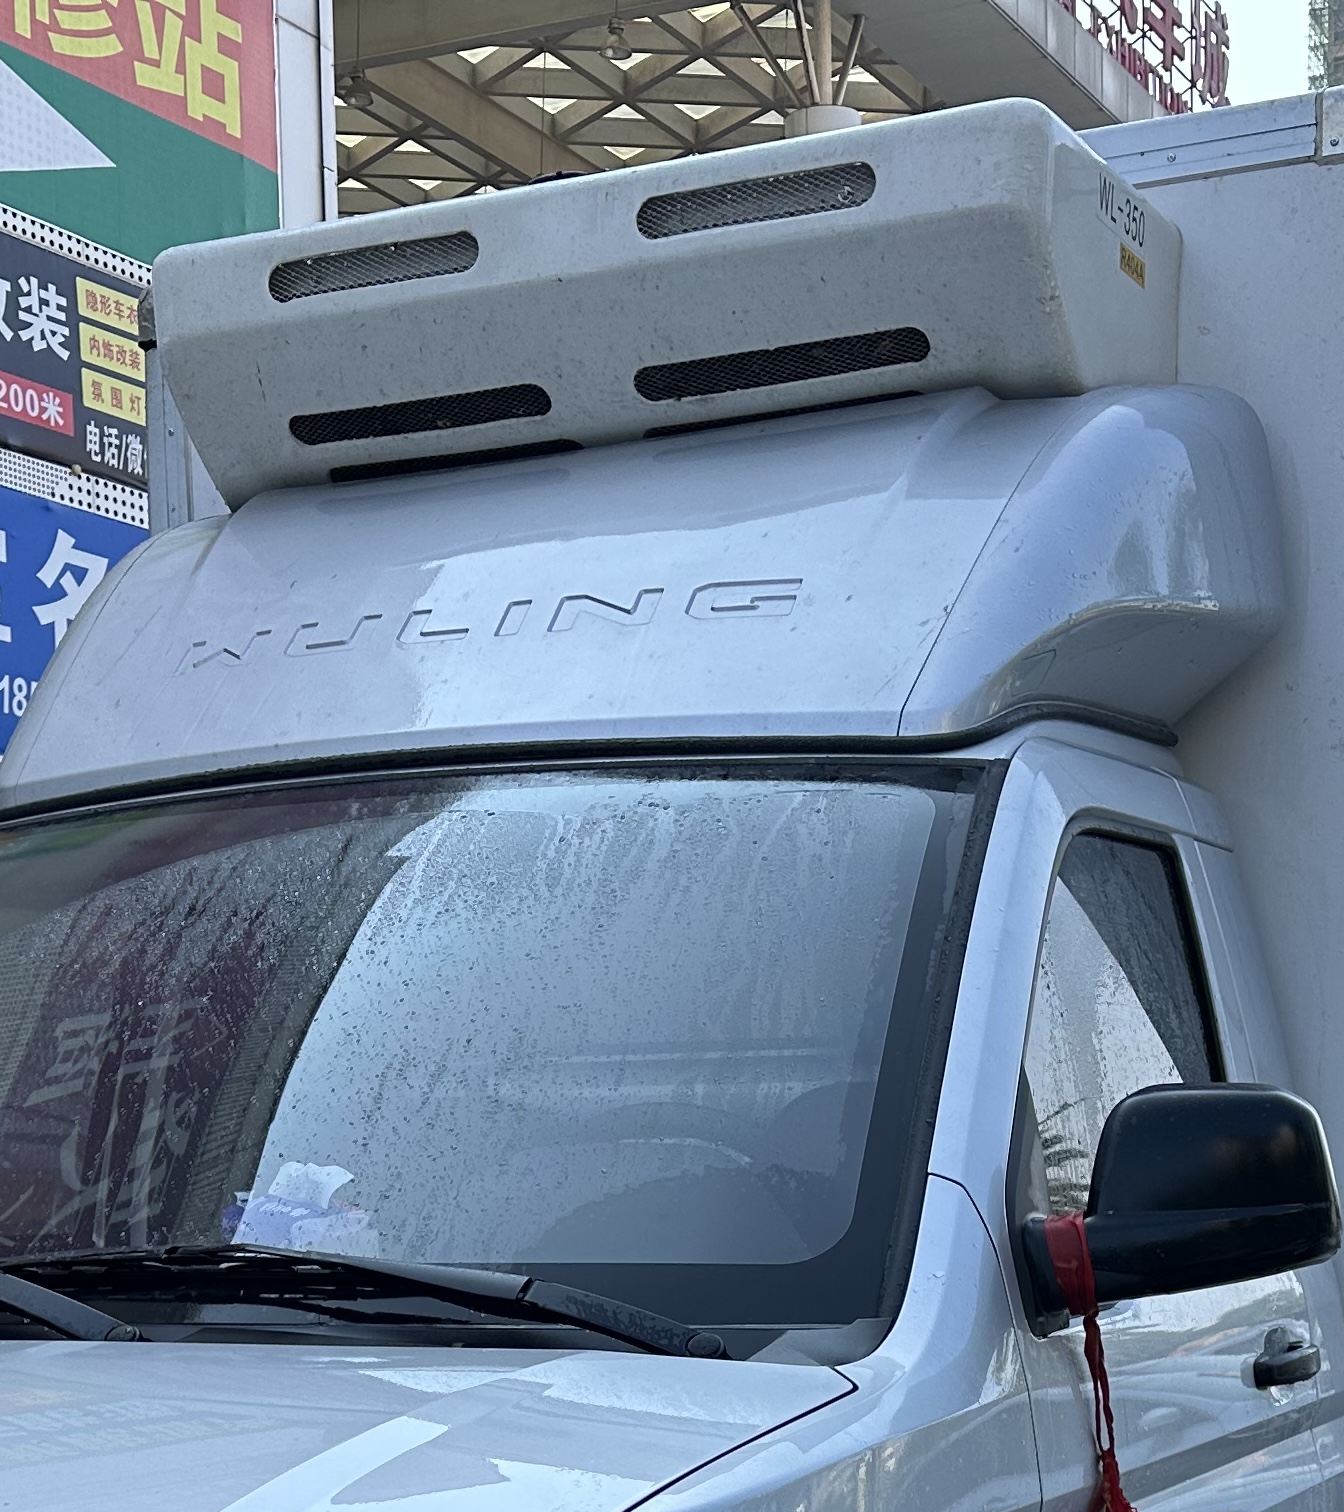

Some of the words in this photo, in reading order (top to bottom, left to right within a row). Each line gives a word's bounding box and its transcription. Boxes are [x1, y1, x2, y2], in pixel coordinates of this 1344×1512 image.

[1098, 172, 1146, 248] WL-350
[1119, 245, 1146, 285] R404A
[88, 333, 142, 372] 内饰改装
[85, 420, 148, 477] 电话/微
[173, 577, 804, 677] WULING
